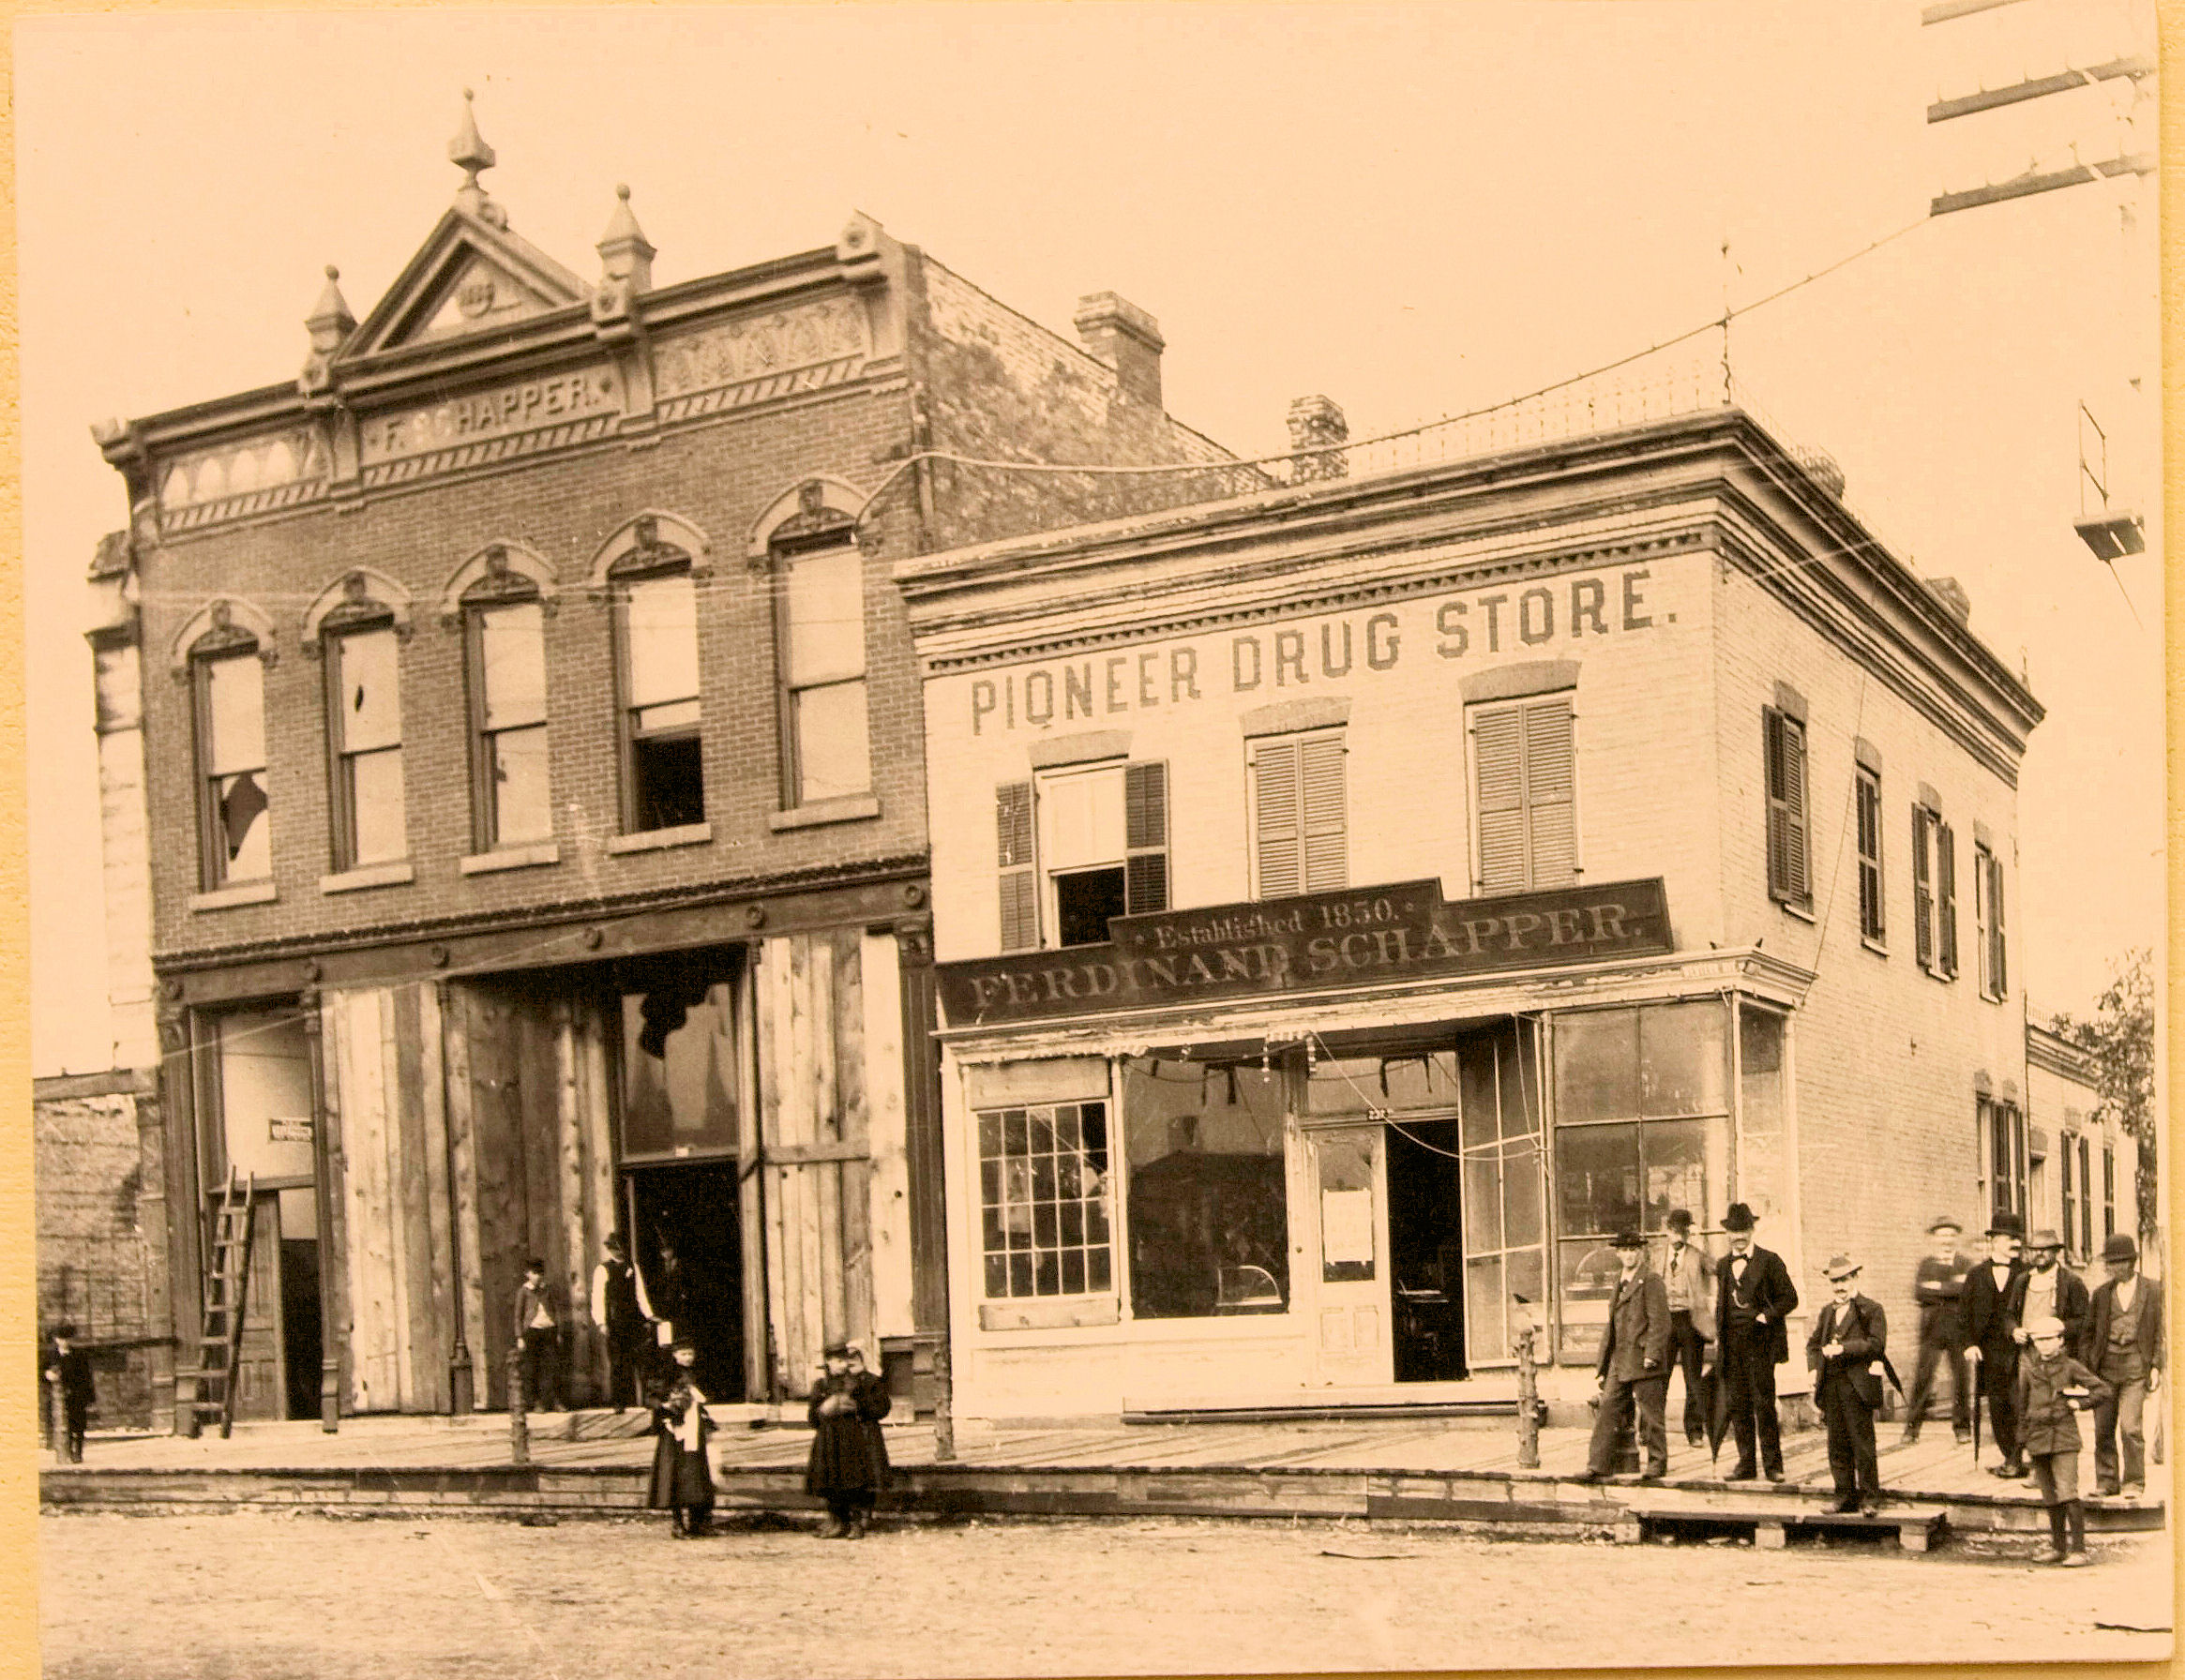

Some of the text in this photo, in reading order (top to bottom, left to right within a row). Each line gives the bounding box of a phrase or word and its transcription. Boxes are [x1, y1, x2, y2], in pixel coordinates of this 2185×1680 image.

[972, 568, 1677, 737] PIONEER DRUG STORE.
[1153, 908, 1304, 949] Established
[971, 943, 1289, 1008] FERDINAND
